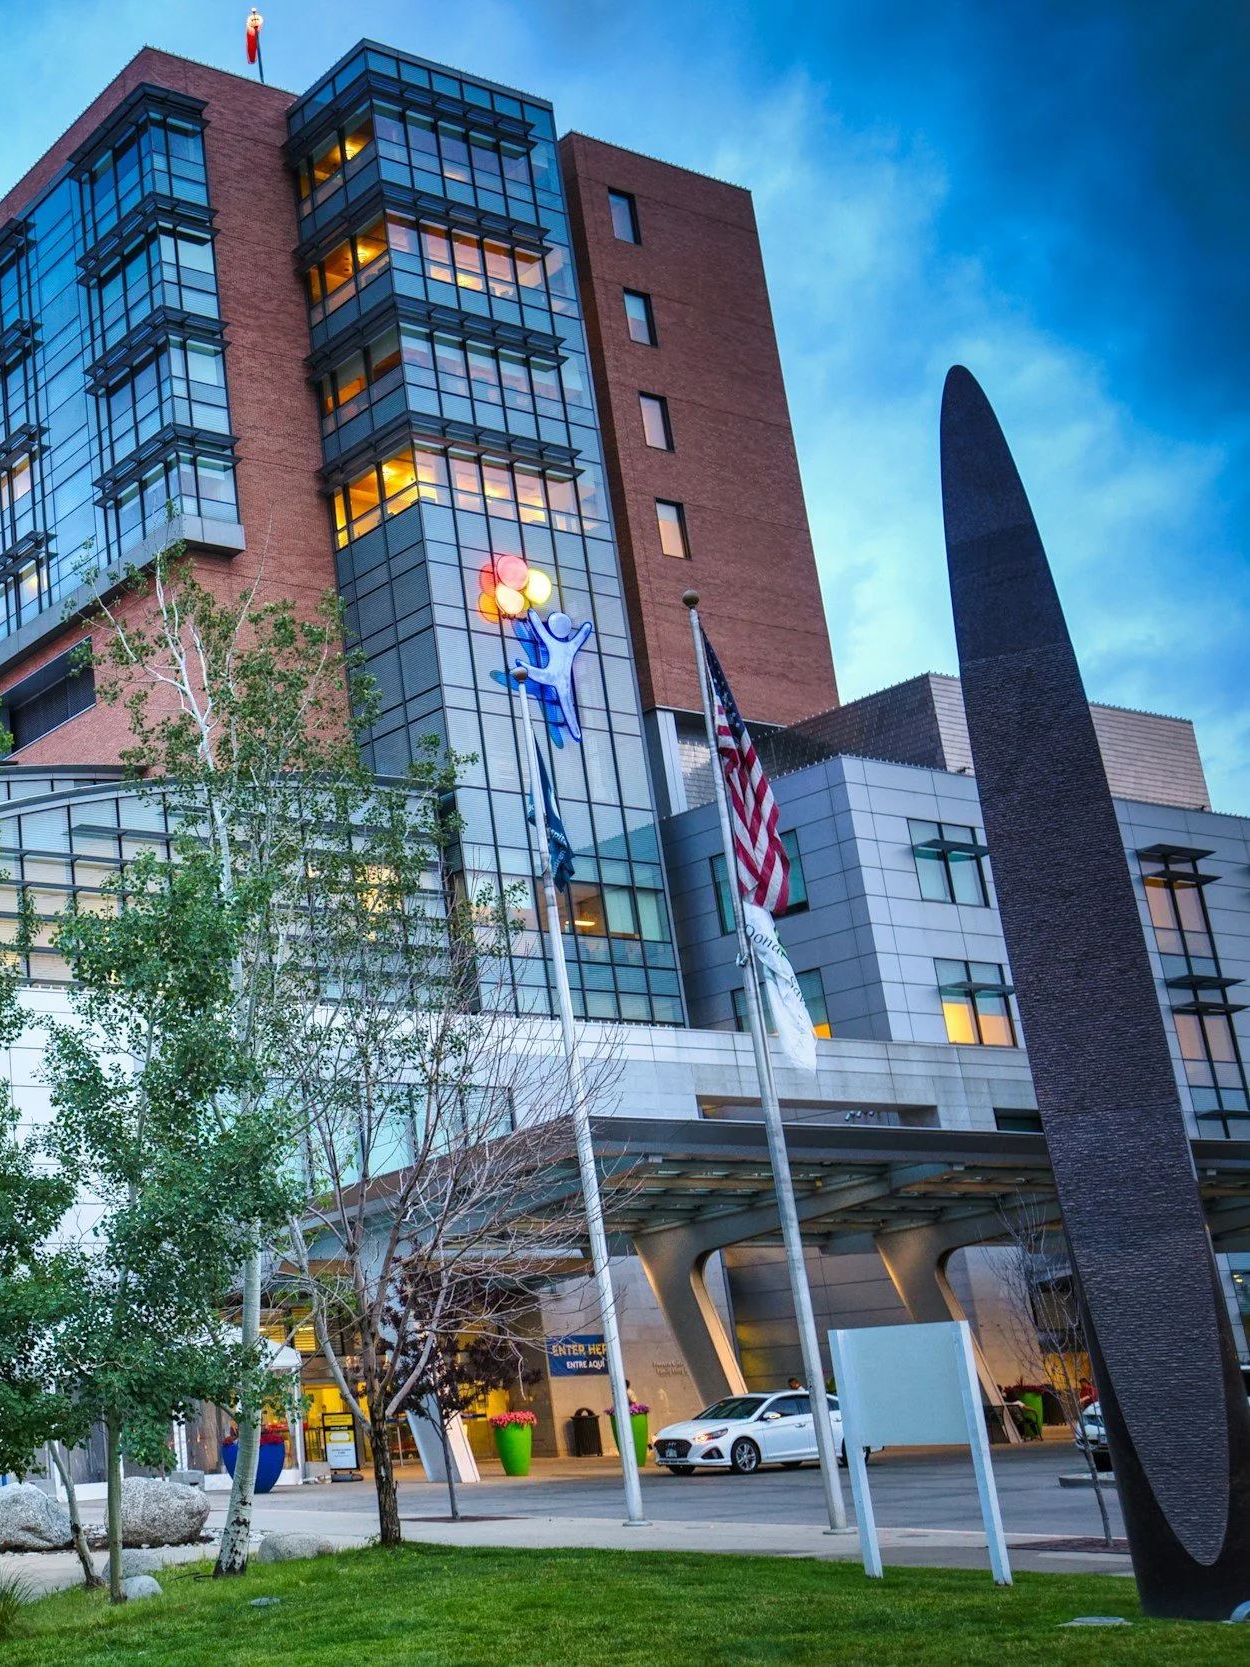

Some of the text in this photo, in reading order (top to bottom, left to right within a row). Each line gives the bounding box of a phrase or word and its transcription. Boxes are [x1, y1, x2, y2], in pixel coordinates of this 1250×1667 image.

[744, 924, 784, 957] Dona
[551, 1343, 607, 1357] ENTER HER
[566, 1360, 588, 1369] ENTRE
